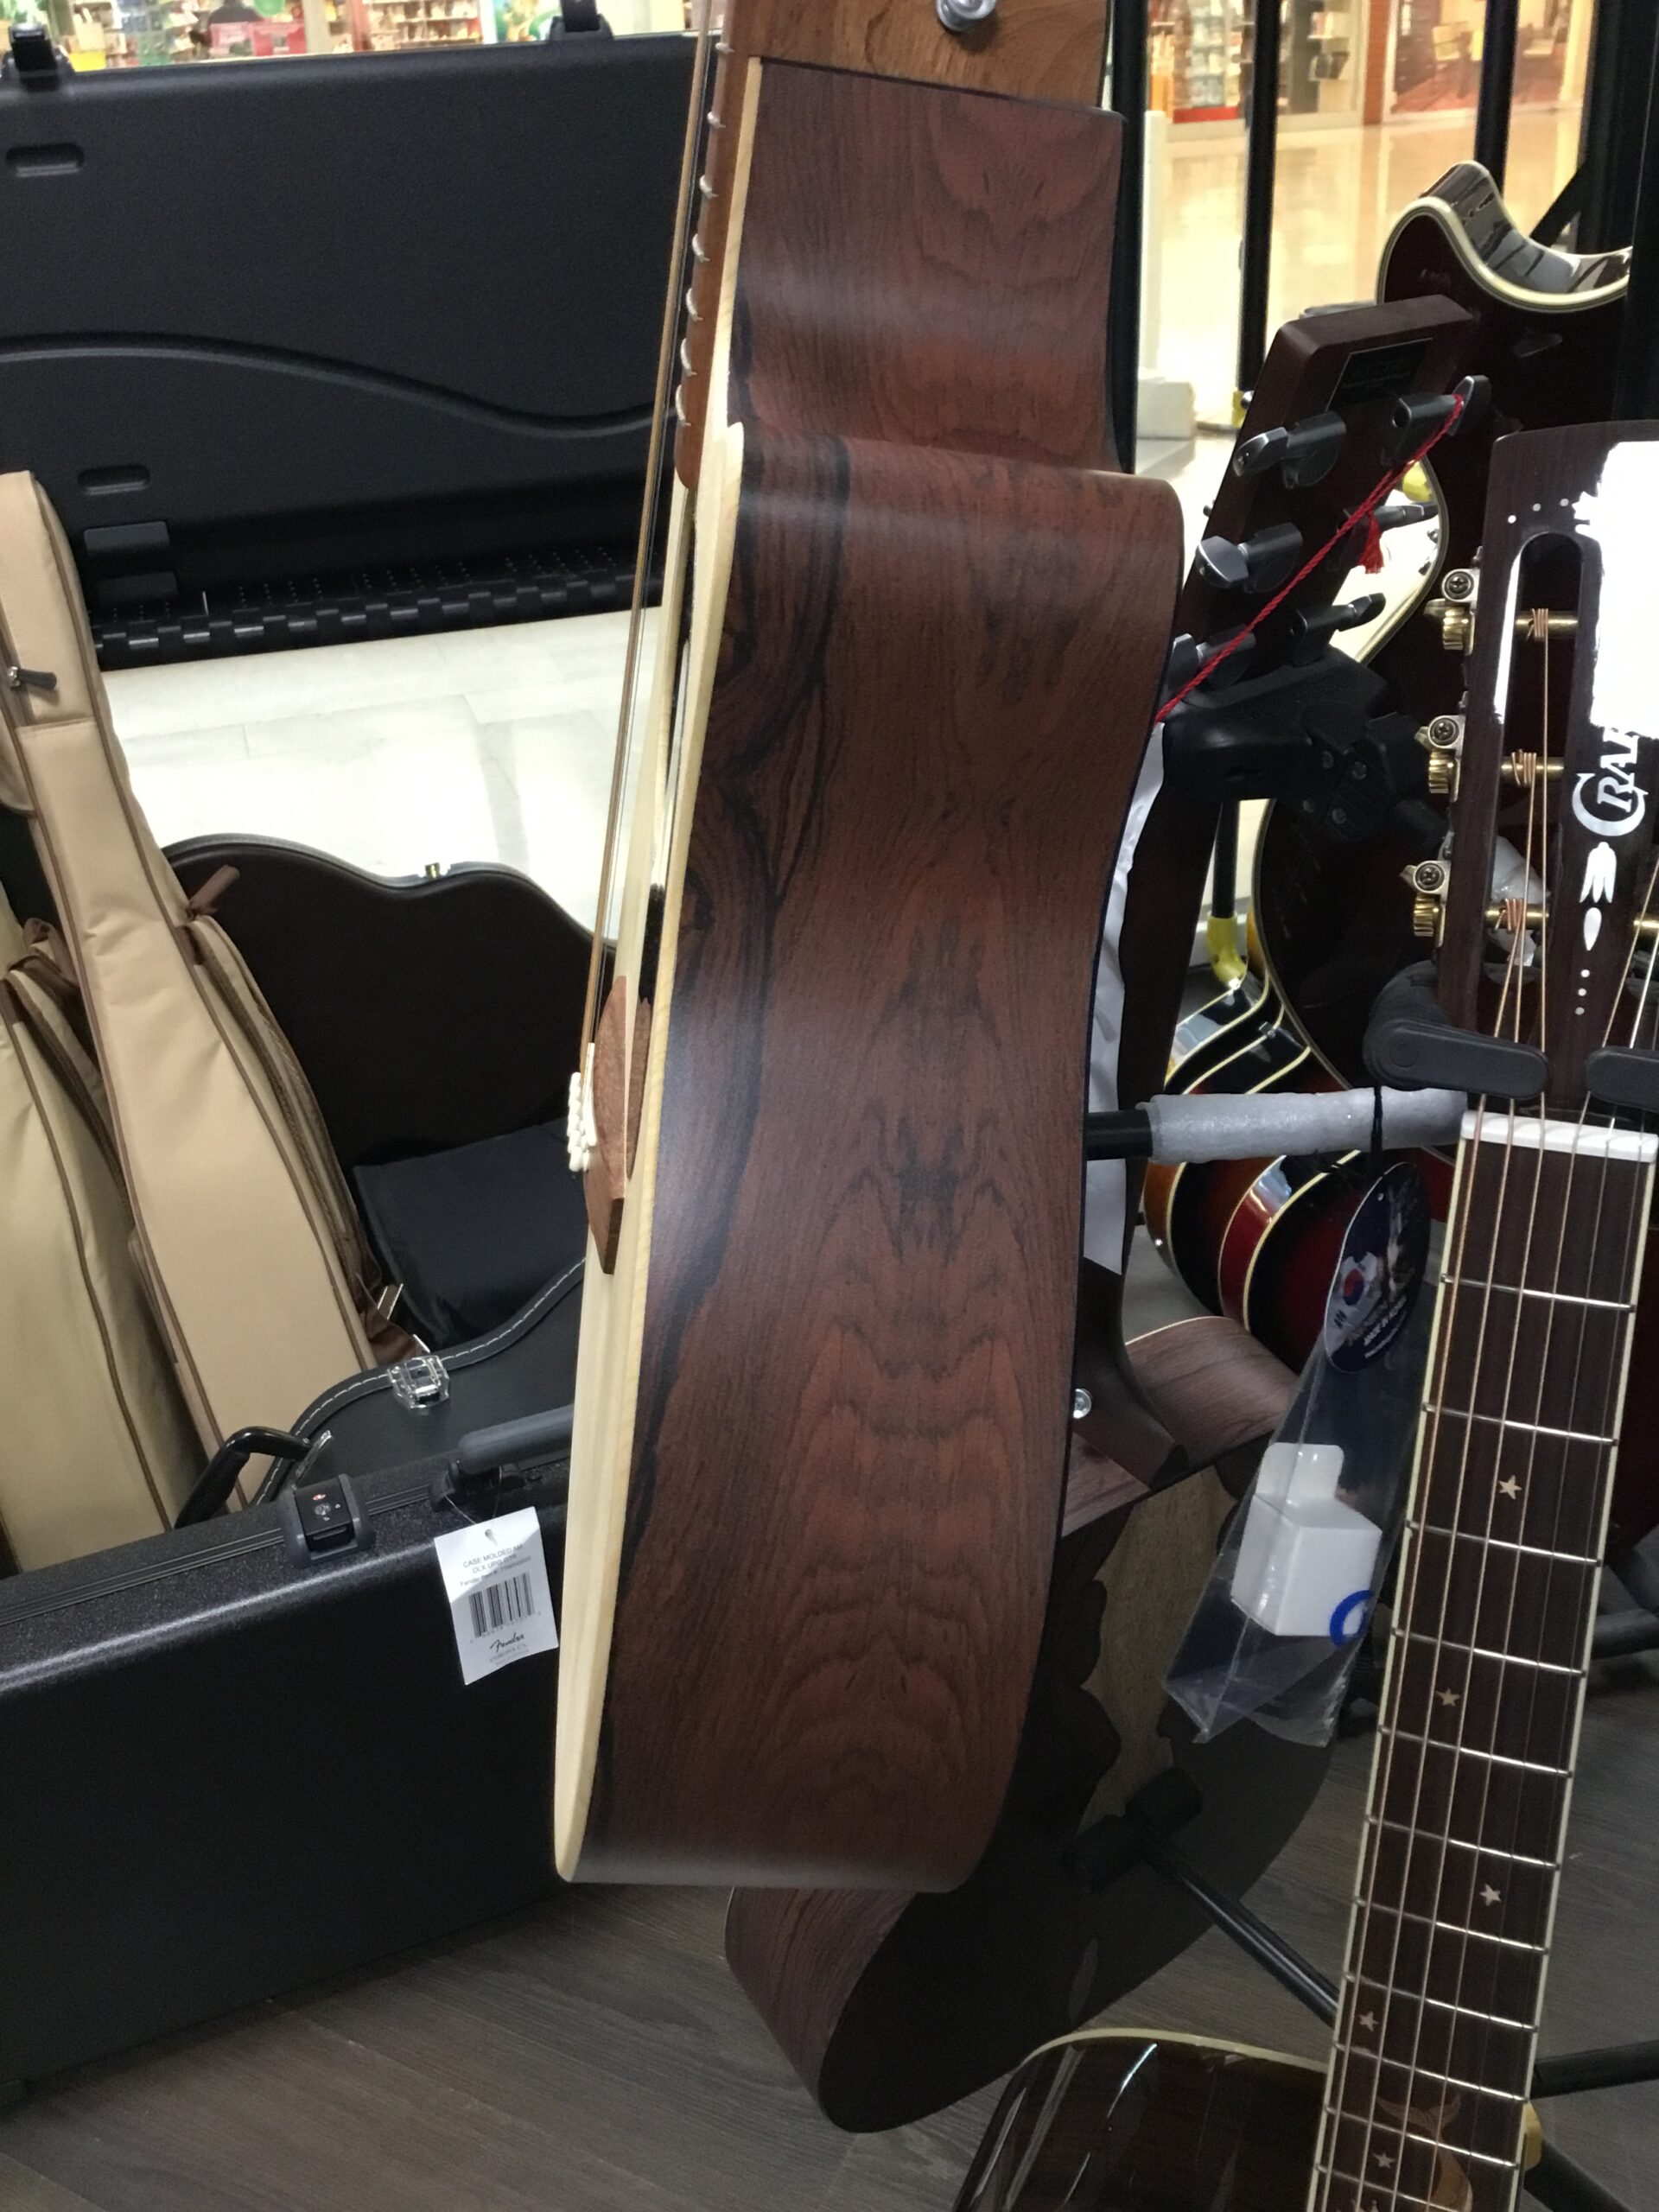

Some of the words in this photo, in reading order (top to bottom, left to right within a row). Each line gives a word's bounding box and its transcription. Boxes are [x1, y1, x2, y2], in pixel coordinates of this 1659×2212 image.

[463, 1557, 481, 1568] CASE
[483, 1548, 512, 1560] MOLDED
[472, 1565, 486, 1573] DLX
[489, 1632, 524, 1653] Fender
